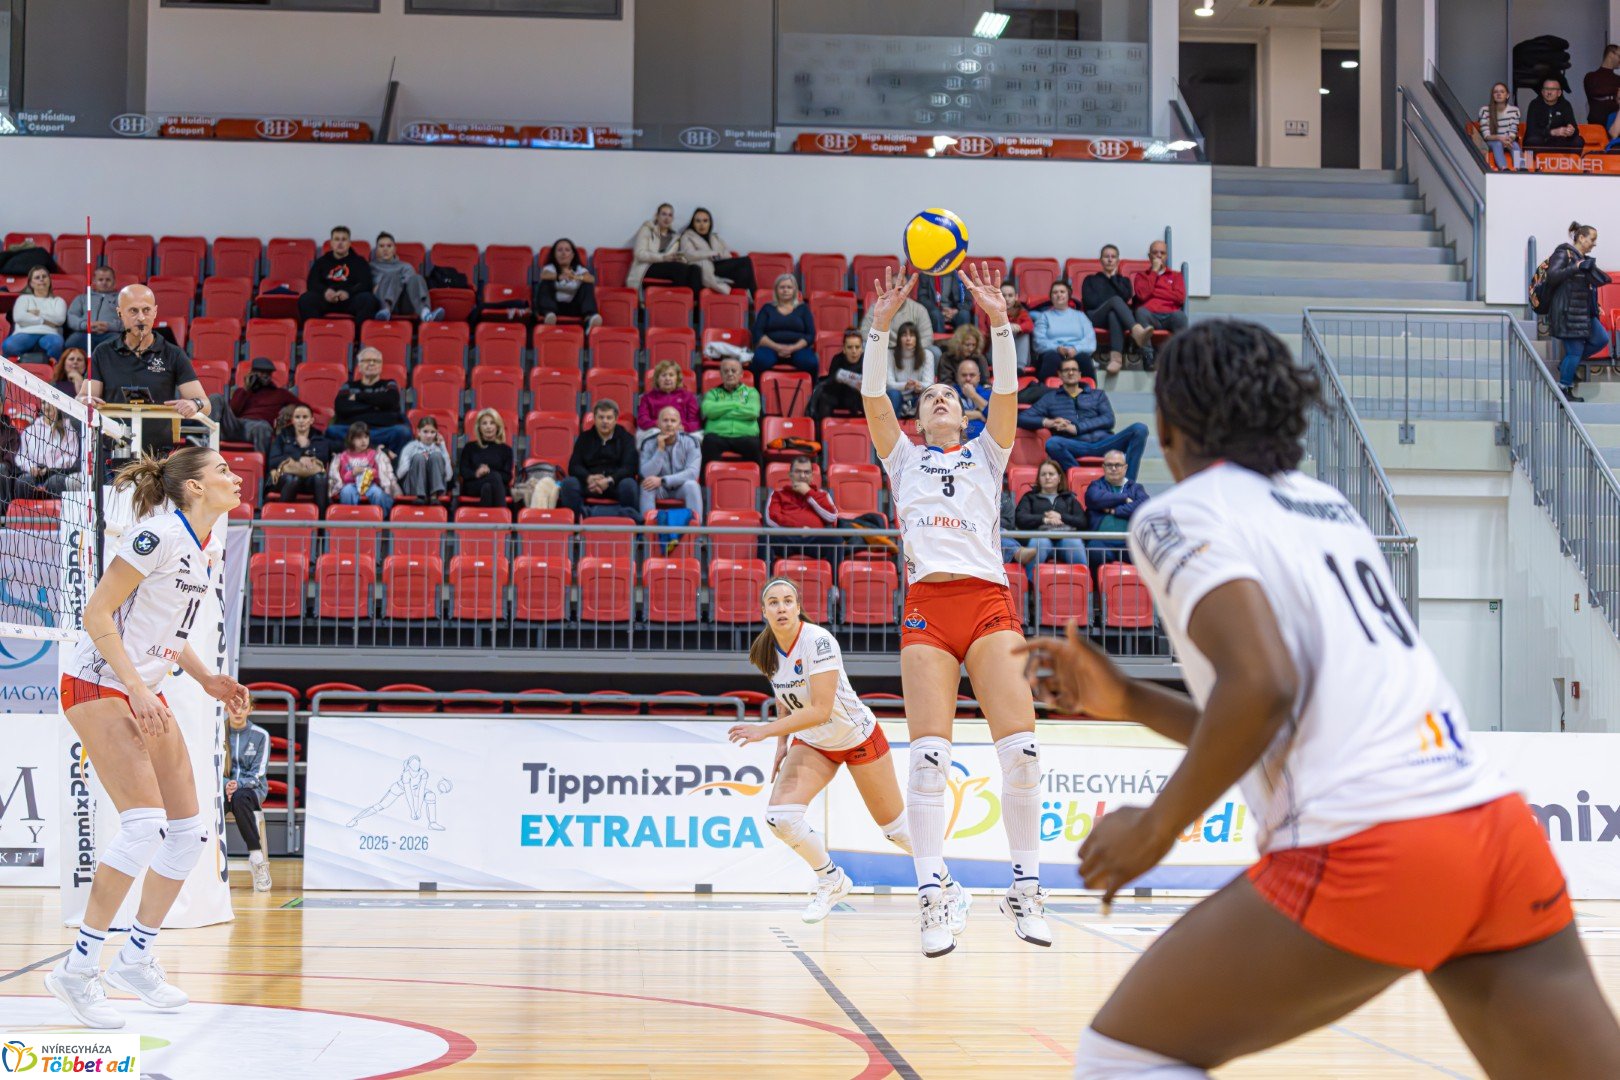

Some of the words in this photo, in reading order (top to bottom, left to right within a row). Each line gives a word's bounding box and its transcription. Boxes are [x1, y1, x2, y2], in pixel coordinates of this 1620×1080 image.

[119, 118, 144, 132] BH
[263, 120, 289, 135] BH
[687, 132, 713, 146] BH
[823, 135, 849, 149] BH
[960, 139, 986, 153] BH
[1096, 142, 1122, 157] BH
[1536, 157, 1603, 171] HÜBNER
[941, 474, 955, 497] 3
[1324, 552, 1415, 648] 19
[181, 597, 200, 630] 11
[782, 692, 803, 710] 18
[522, 762, 765, 804] TippmixPRO
[1040, 769, 1168, 794] ÍREGYHÁZ
[70, 741, 93, 888] TippmixPRO
[521, 814, 764, 849] EXTRALIGA
[359, 835, 389, 850] 2025
[399, 836, 429, 851] 2026
